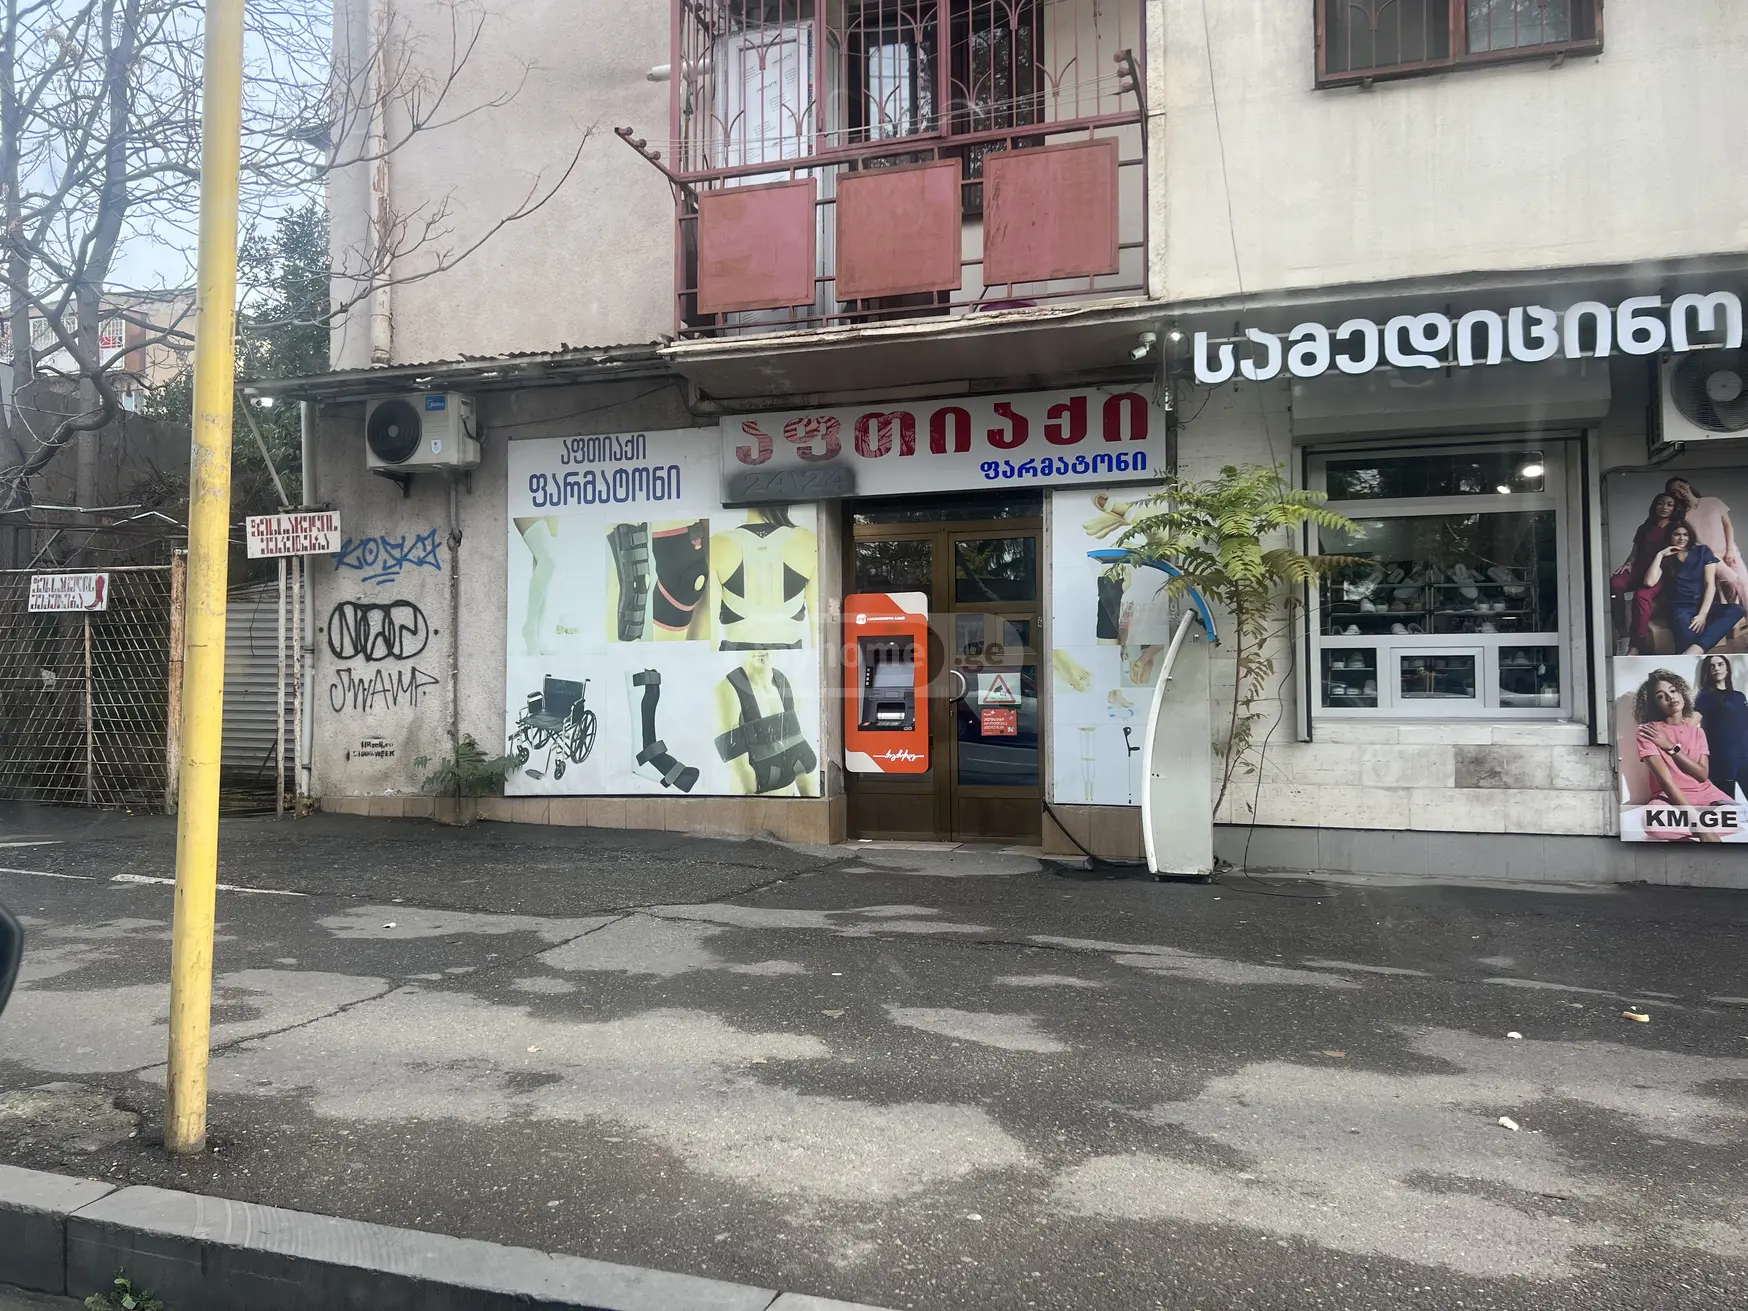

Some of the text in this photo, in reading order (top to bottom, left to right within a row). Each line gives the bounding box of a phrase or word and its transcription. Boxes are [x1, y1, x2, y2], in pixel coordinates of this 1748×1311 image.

[1194, 291, 1742, 384] სამედიცინო
[735, 391, 1149, 466] აფთიაქი
[561, 434, 646, 465] აფთიაქი
[980, 450, 1148, 480] ფარმატონი
[529, 465, 681, 507] ფარმატონი
[1645, 810, 1738, 828] KM.GE
